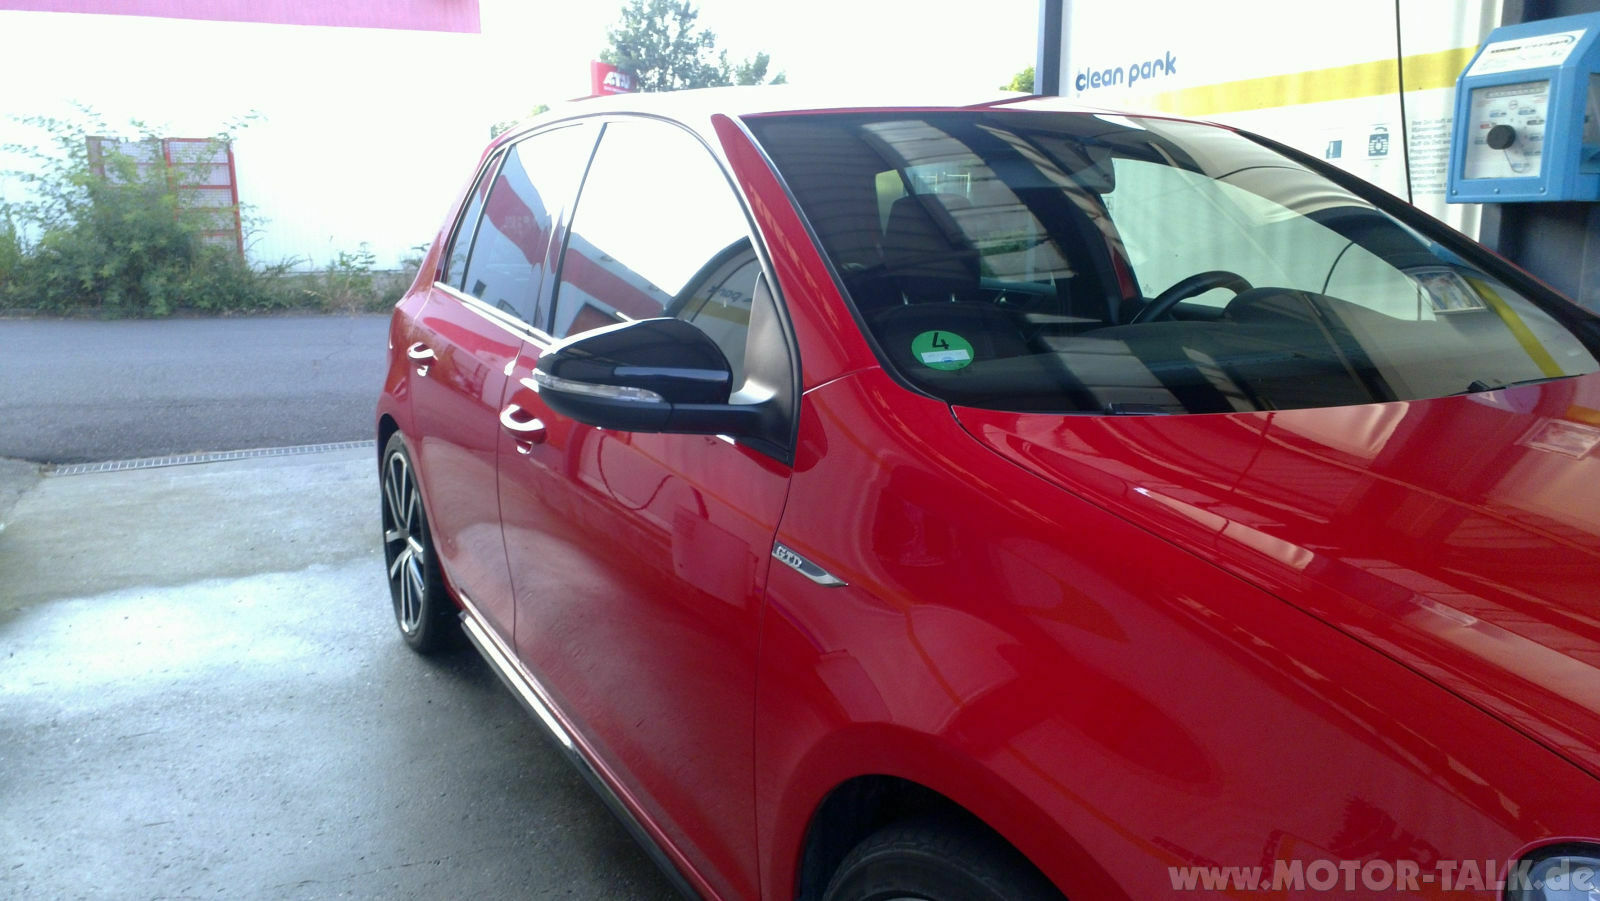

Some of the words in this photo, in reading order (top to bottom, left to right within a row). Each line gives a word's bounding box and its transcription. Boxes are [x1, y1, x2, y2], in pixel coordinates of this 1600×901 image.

[1075, 66, 1124, 92] clean
[1128, 50, 1177, 88] park
[932, 331, 950, 350] 4
[775, 545, 803, 569] GTD
